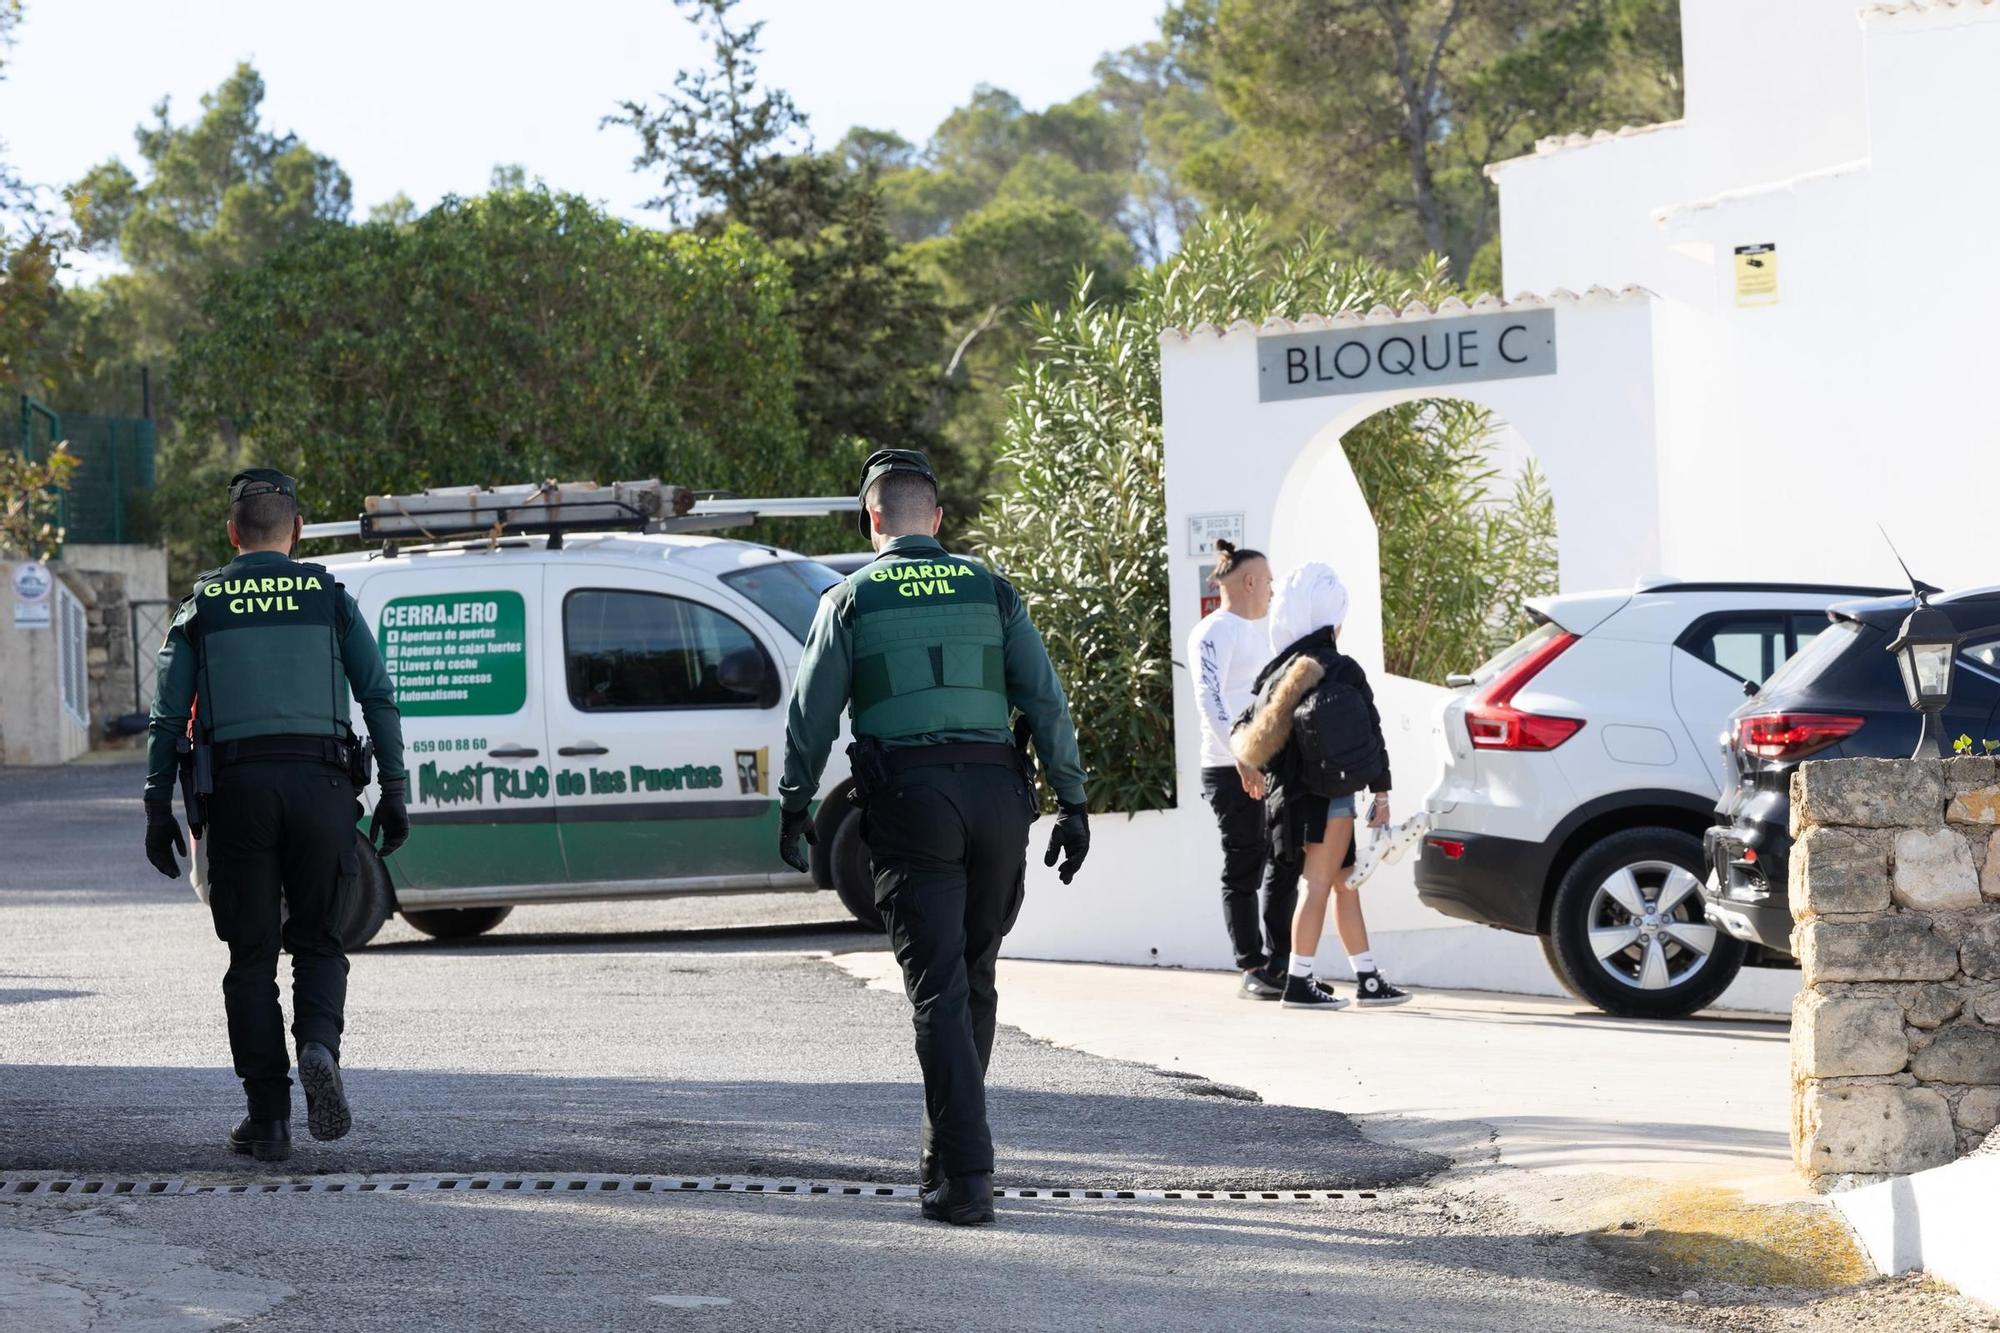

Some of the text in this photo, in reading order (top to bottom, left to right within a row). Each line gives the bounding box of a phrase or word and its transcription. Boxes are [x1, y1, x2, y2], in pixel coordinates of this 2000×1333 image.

[1287, 325, 1528, 384] BLOQUE C
[869, 564, 975, 582] GUARDIA
[204, 576, 323, 597] GUARDIA
[898, 579, 955, 597] CIVIL
[229, 596, 299, 614] CIVIL
[382, 601, 498, 628] CERRAJERO
[400, 628, 496, 643] Apertura de puertas
[400, 641, 522, 658] Apertura de cajas fuertes
[400, 658, 478, 672] Llaves de coche
[400, 673, 492, 687] Control de accesos
[400, 689, 468, 702] Automatismos
[413, 737, 487, 752] 659 00 88 60
[556, 769, 586, 796] de
[589, 768, 627, 795] las
[630, 764, 723, 792] Puertas
